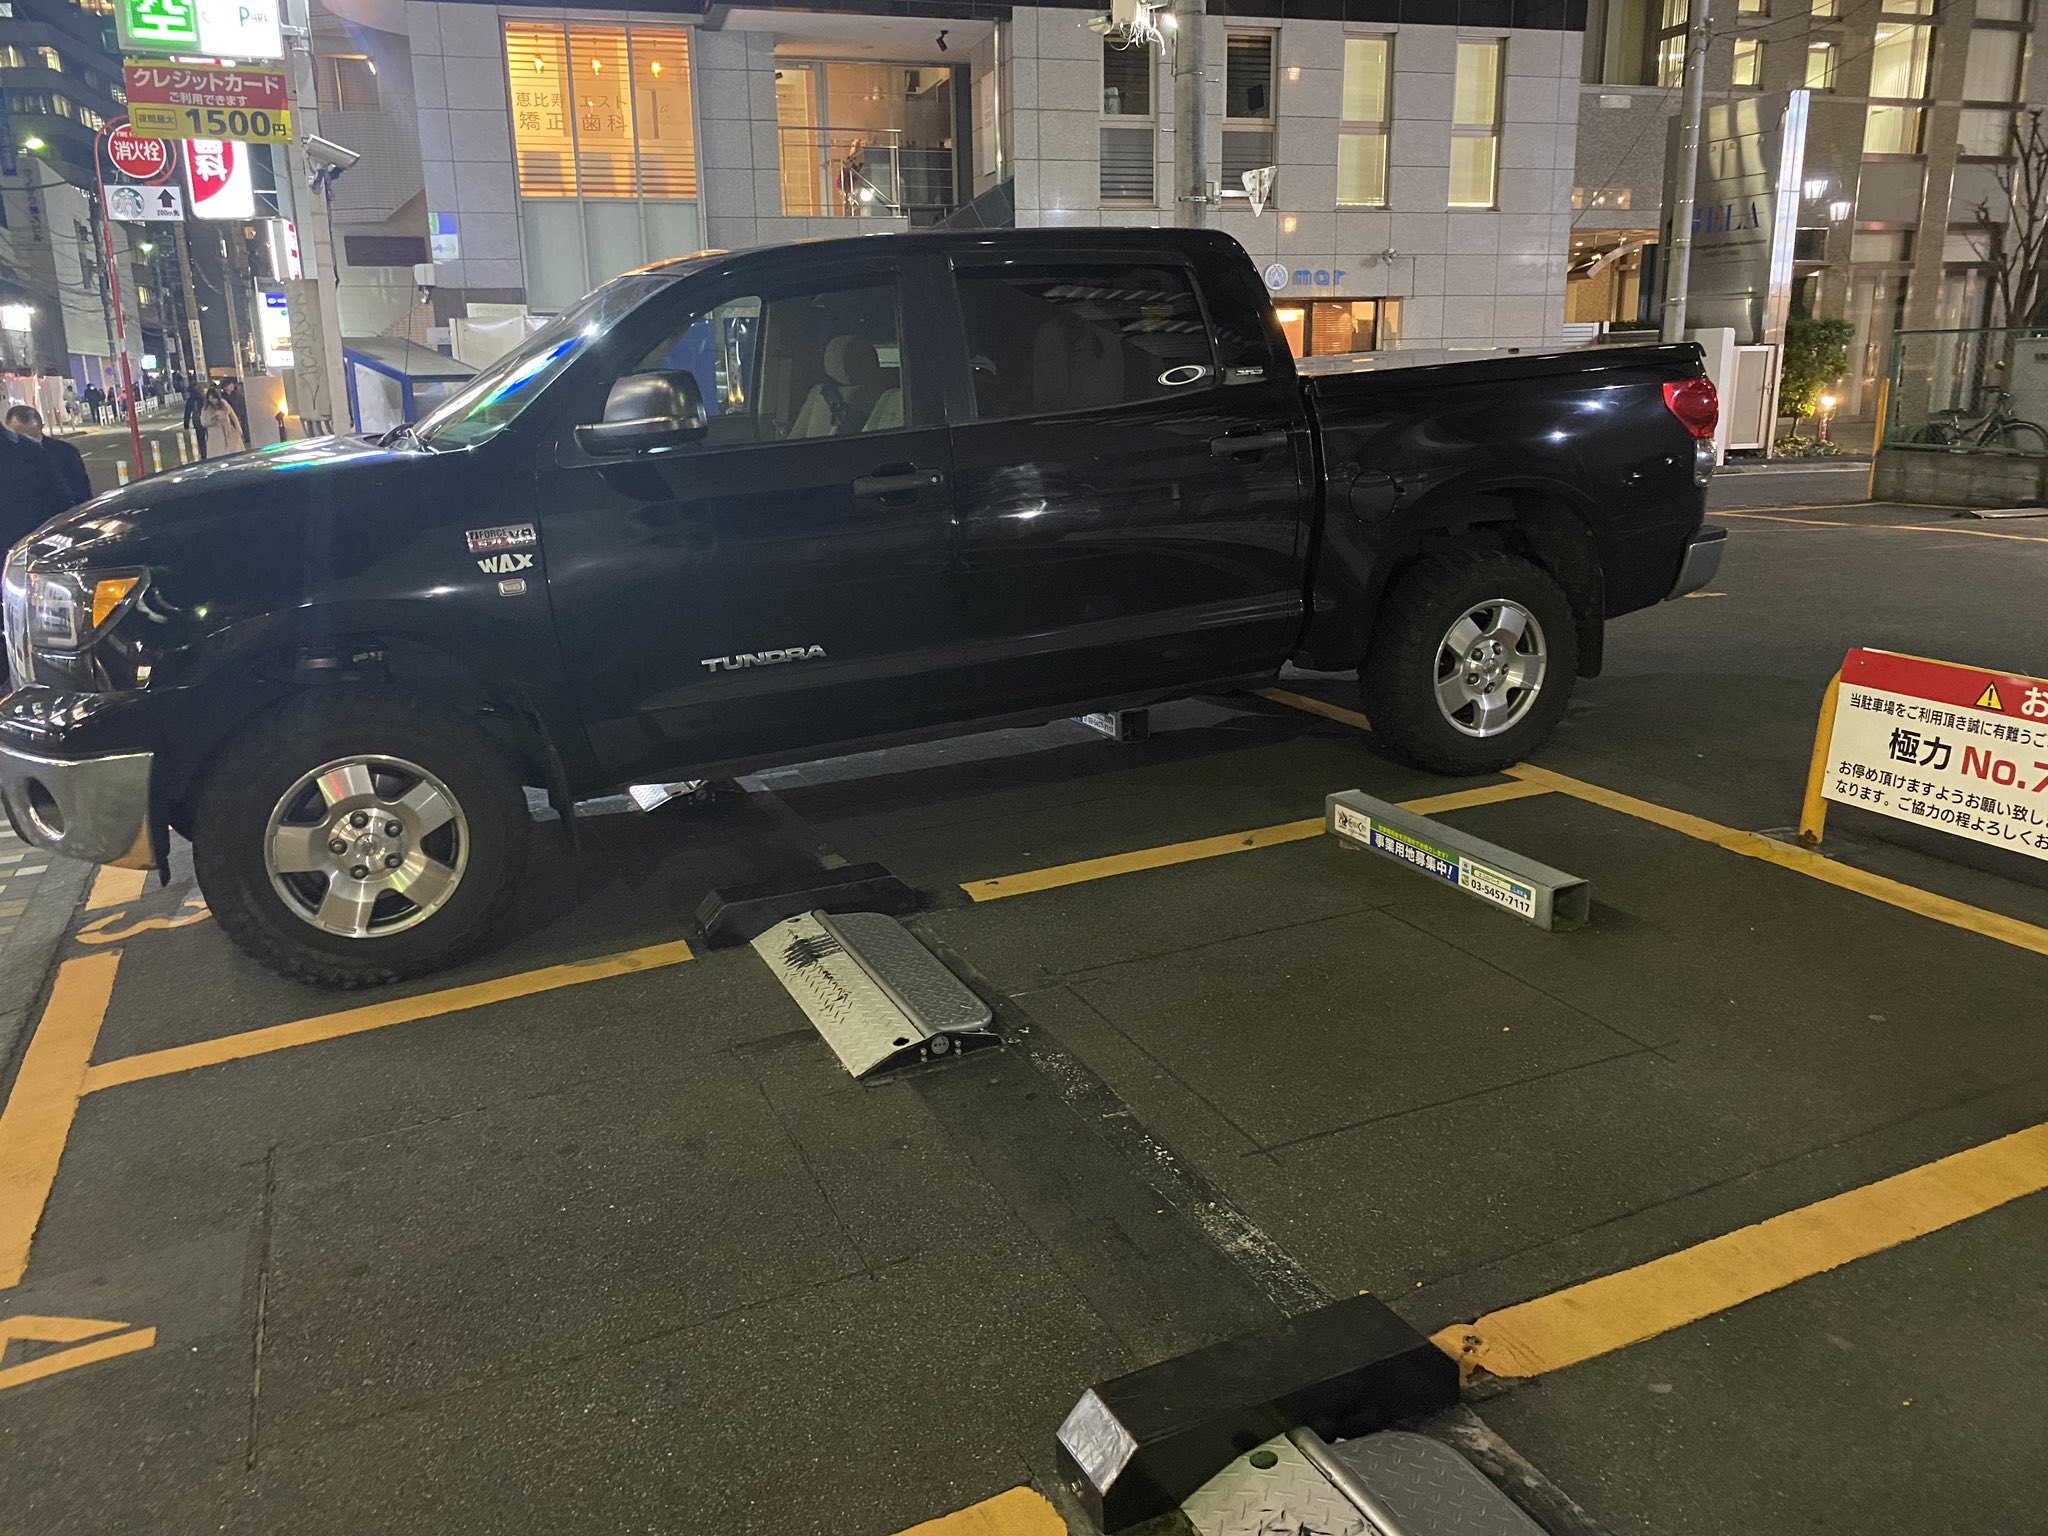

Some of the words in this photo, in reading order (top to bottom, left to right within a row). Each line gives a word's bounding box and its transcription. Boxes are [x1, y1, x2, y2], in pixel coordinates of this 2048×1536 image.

[133, 68, 279, 94] クレジットカード
[169, 92, 248, 106] ご利用できます
[114, 140, 162, 162] 消火栓
[477, 554, 534, 573] WAX
[701, 644, 827, 673] TUNDRA
[1850, 693, 2048, 748] 当駐車場をご利用頂き誠に有難うご
[1888, 727, 1952, 771] 極力
[1838, 760, 2048, 829] お停め頂けますようお願い致し
[1471, 879, 1530, 912] 03-5457-7117
